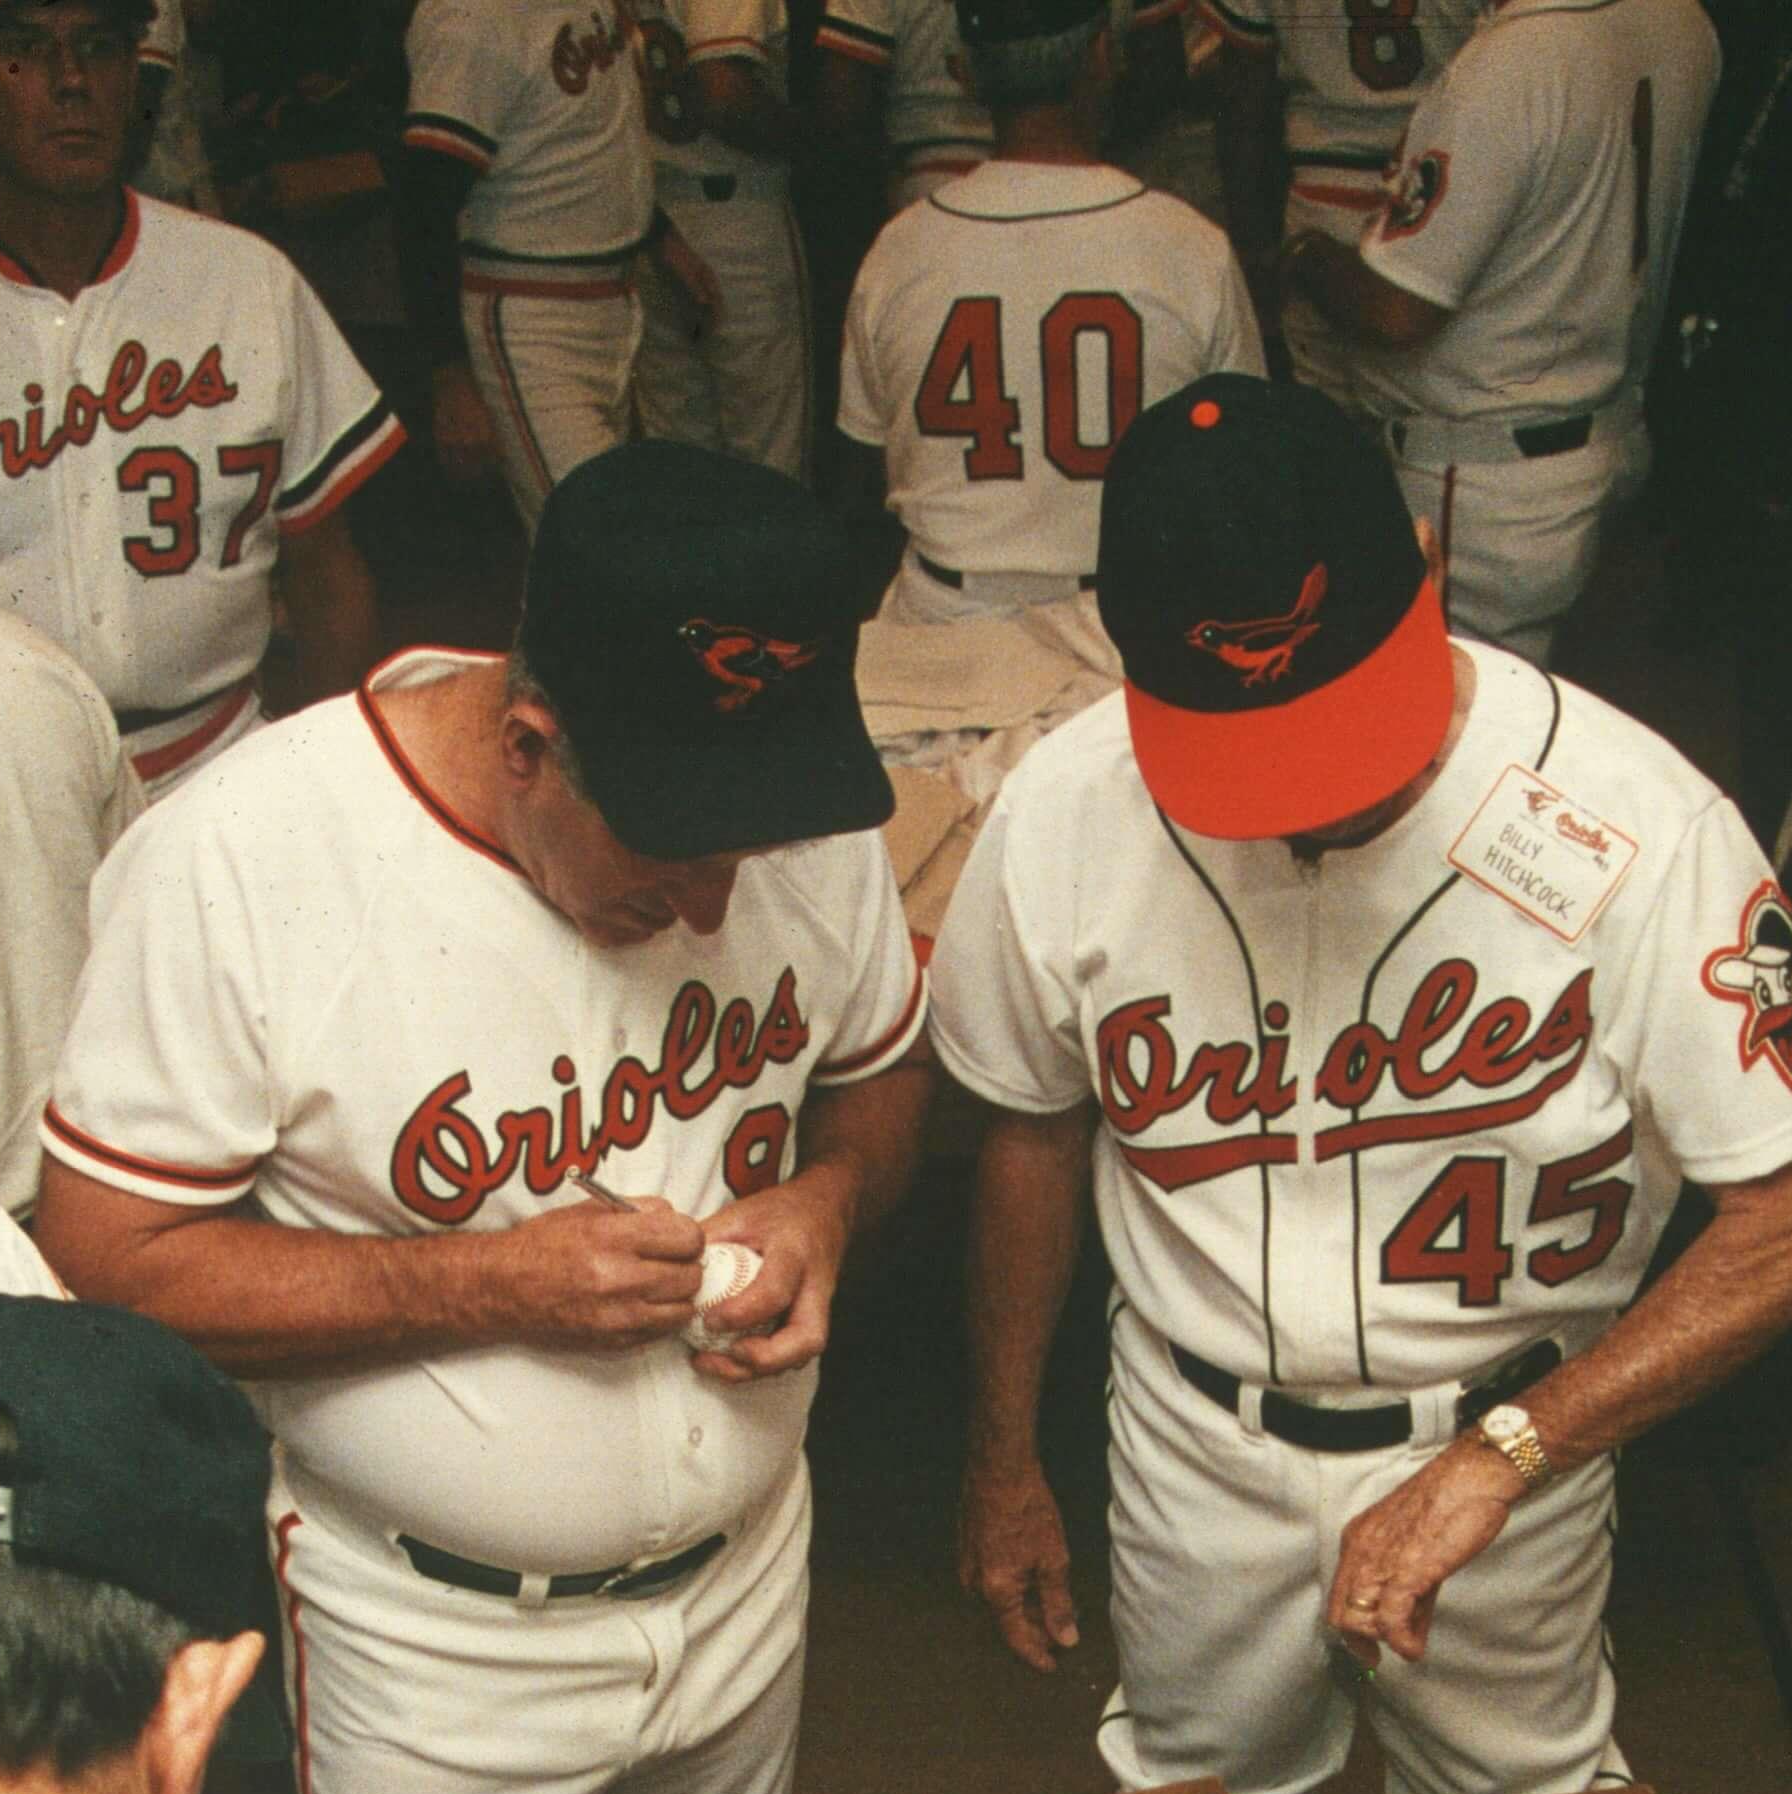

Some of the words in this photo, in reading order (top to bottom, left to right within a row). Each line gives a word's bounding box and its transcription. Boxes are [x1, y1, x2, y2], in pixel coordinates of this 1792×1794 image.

[914, 289, 1143, 482] 40
[117, 443, 285, 578] 37
[1483, 845, 1577, 920] HITCHCOCK
[1498, 823, 1544, 860] BILLY
[390, 966, 810, 1225] Orioles
[1095, 957, 1595, 1137] Orioles
[1380, 1119, 1635, 1308] 45
